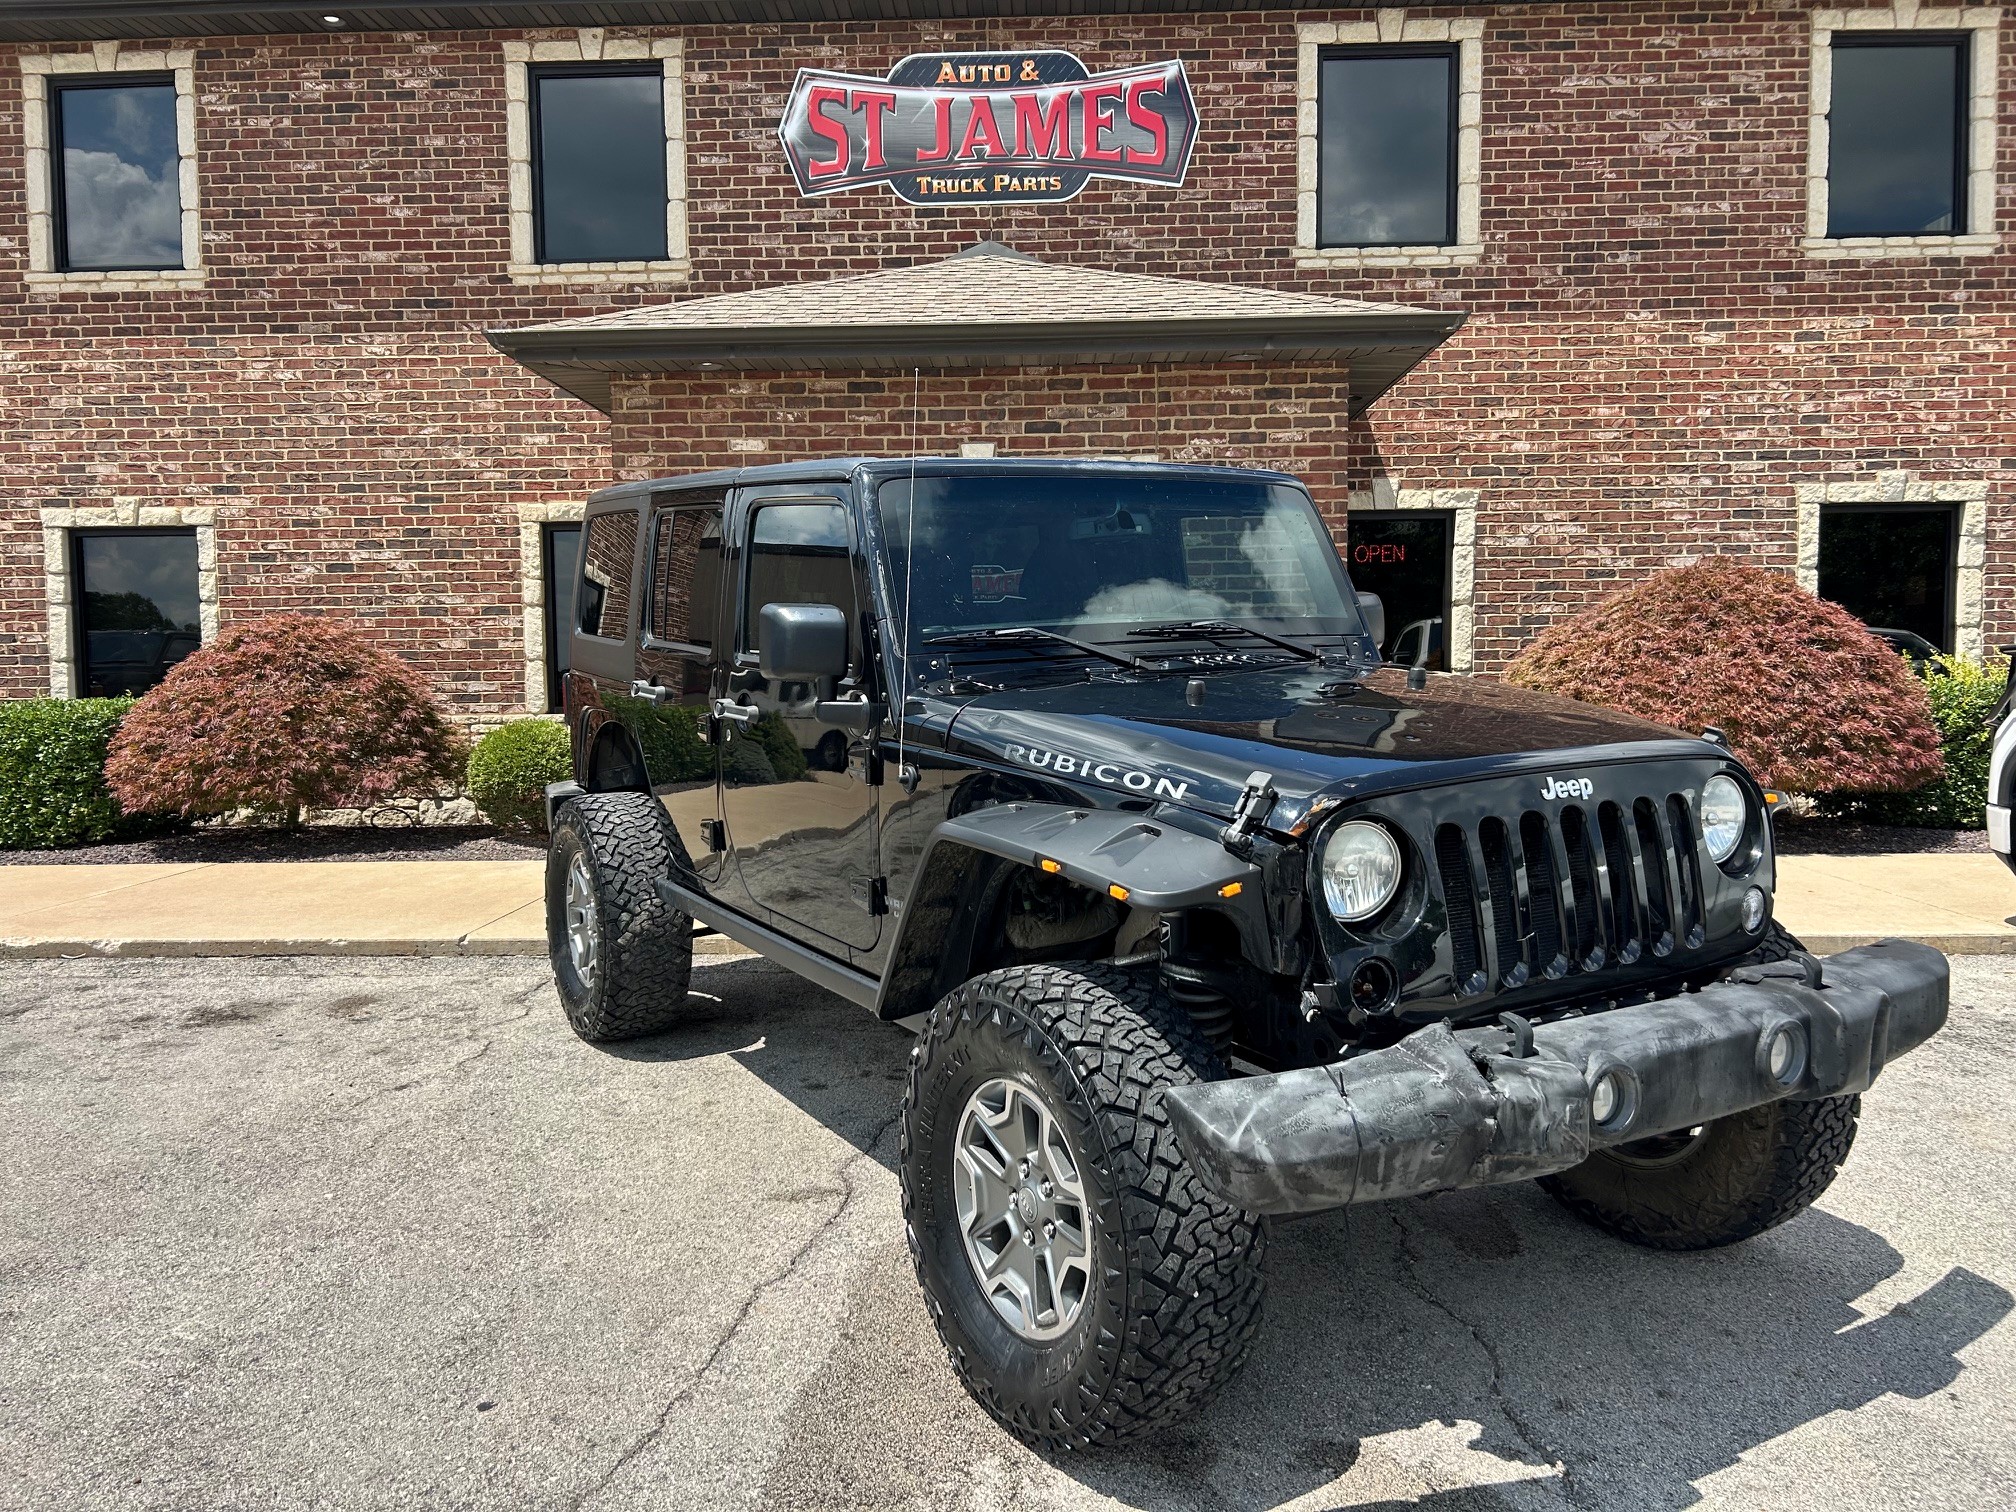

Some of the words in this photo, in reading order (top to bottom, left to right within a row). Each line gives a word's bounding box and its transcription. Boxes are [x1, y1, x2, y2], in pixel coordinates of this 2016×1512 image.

[936, 62, 1010, 84] AUTO
[1019, 60, 1040, 81] &
[808, 86, 897, 178] ST
[916, 77, 1169, 165] JAMES
[917, 175, 985, 195] TRUCK
[994, 175, 1062, 192] PARTS
[1354, 544, 1406, 563] OPEN
[1003, 743, 1188, 799] RUBICON
[1540, 776, 1594, 800] Jeep
